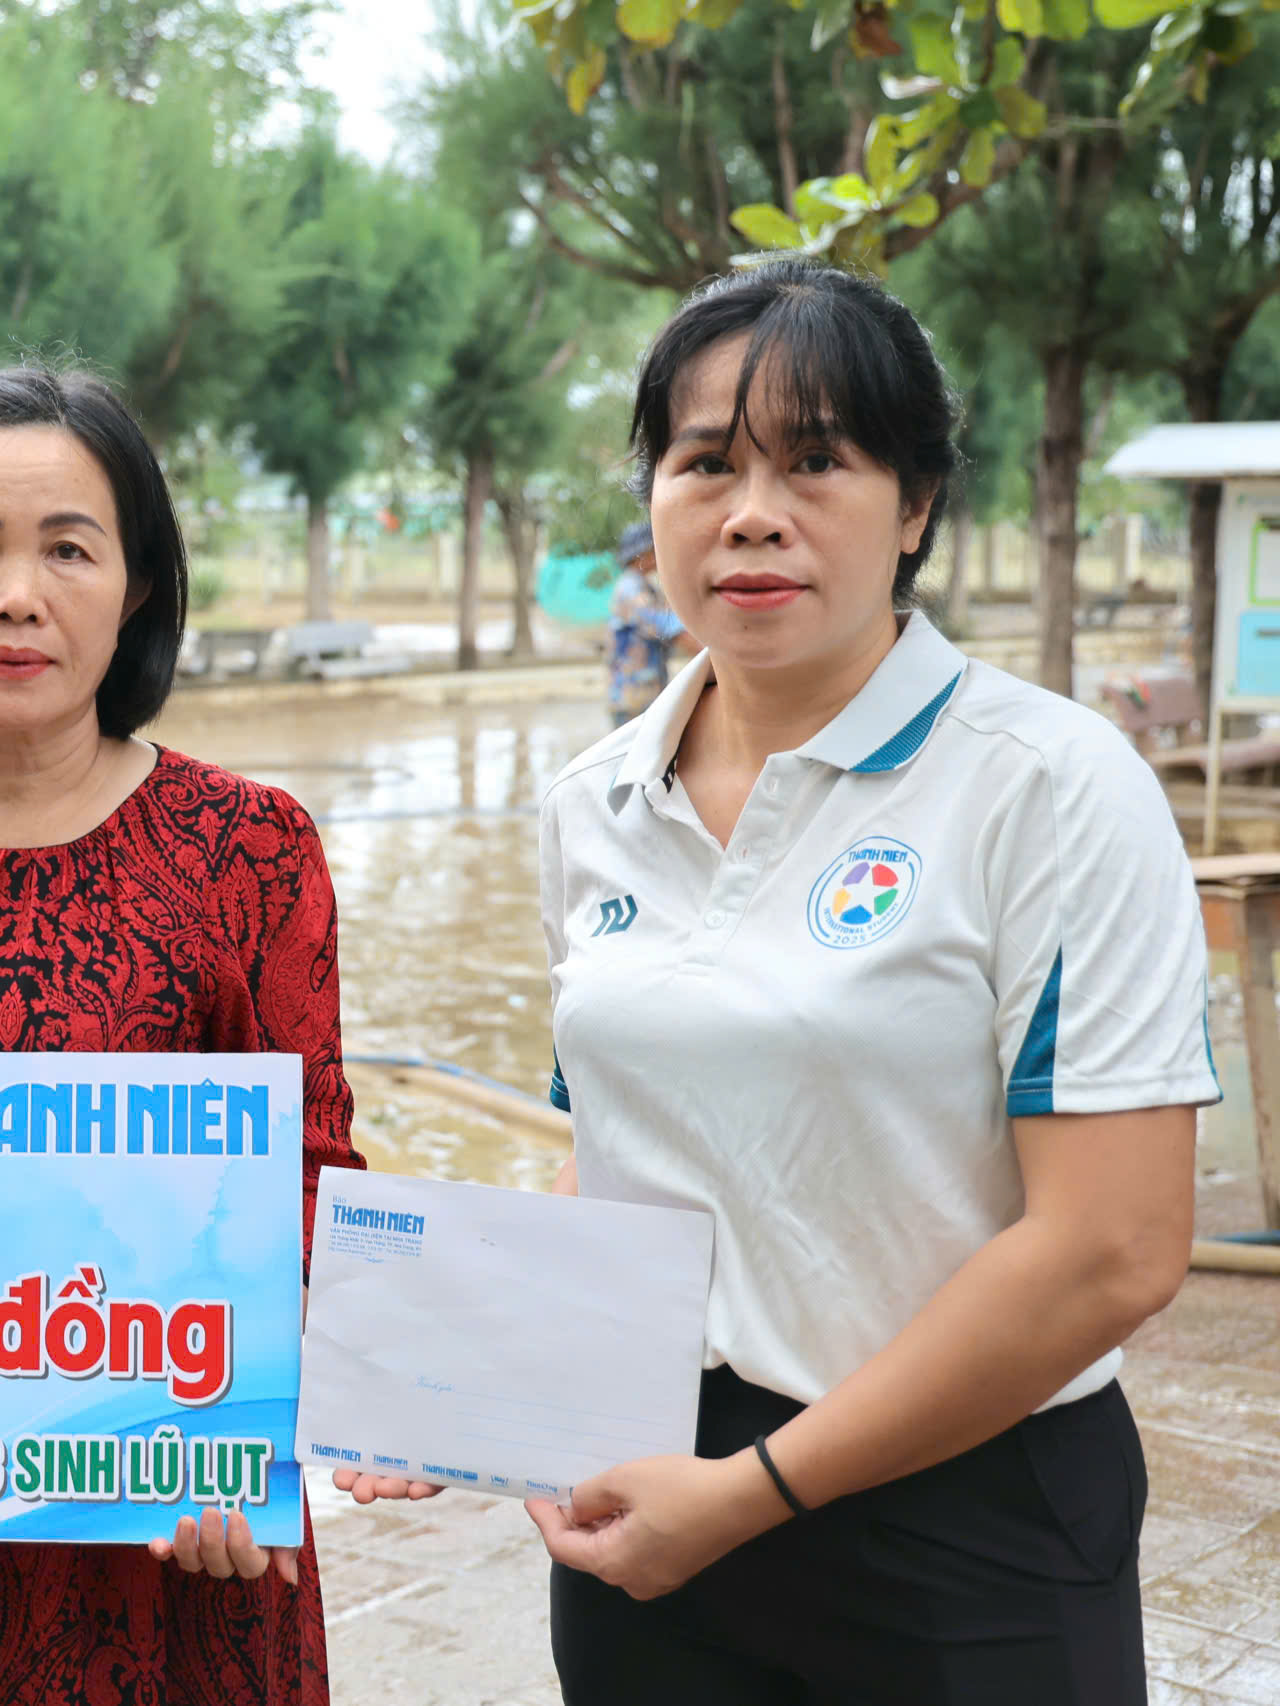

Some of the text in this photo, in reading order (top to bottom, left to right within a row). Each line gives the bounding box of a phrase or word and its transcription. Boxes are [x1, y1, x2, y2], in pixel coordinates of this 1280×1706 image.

[126, 1077, 269, 1156] NIÊN
[332, 1204, 386, 1230] THANH
[14, 1438, 115, 1494] SINH
[130, 1431, 179, 1496] LŨ
[194, 1442, 268, 1509] LỤT
[311, 1443, 340, 1460] THANH
